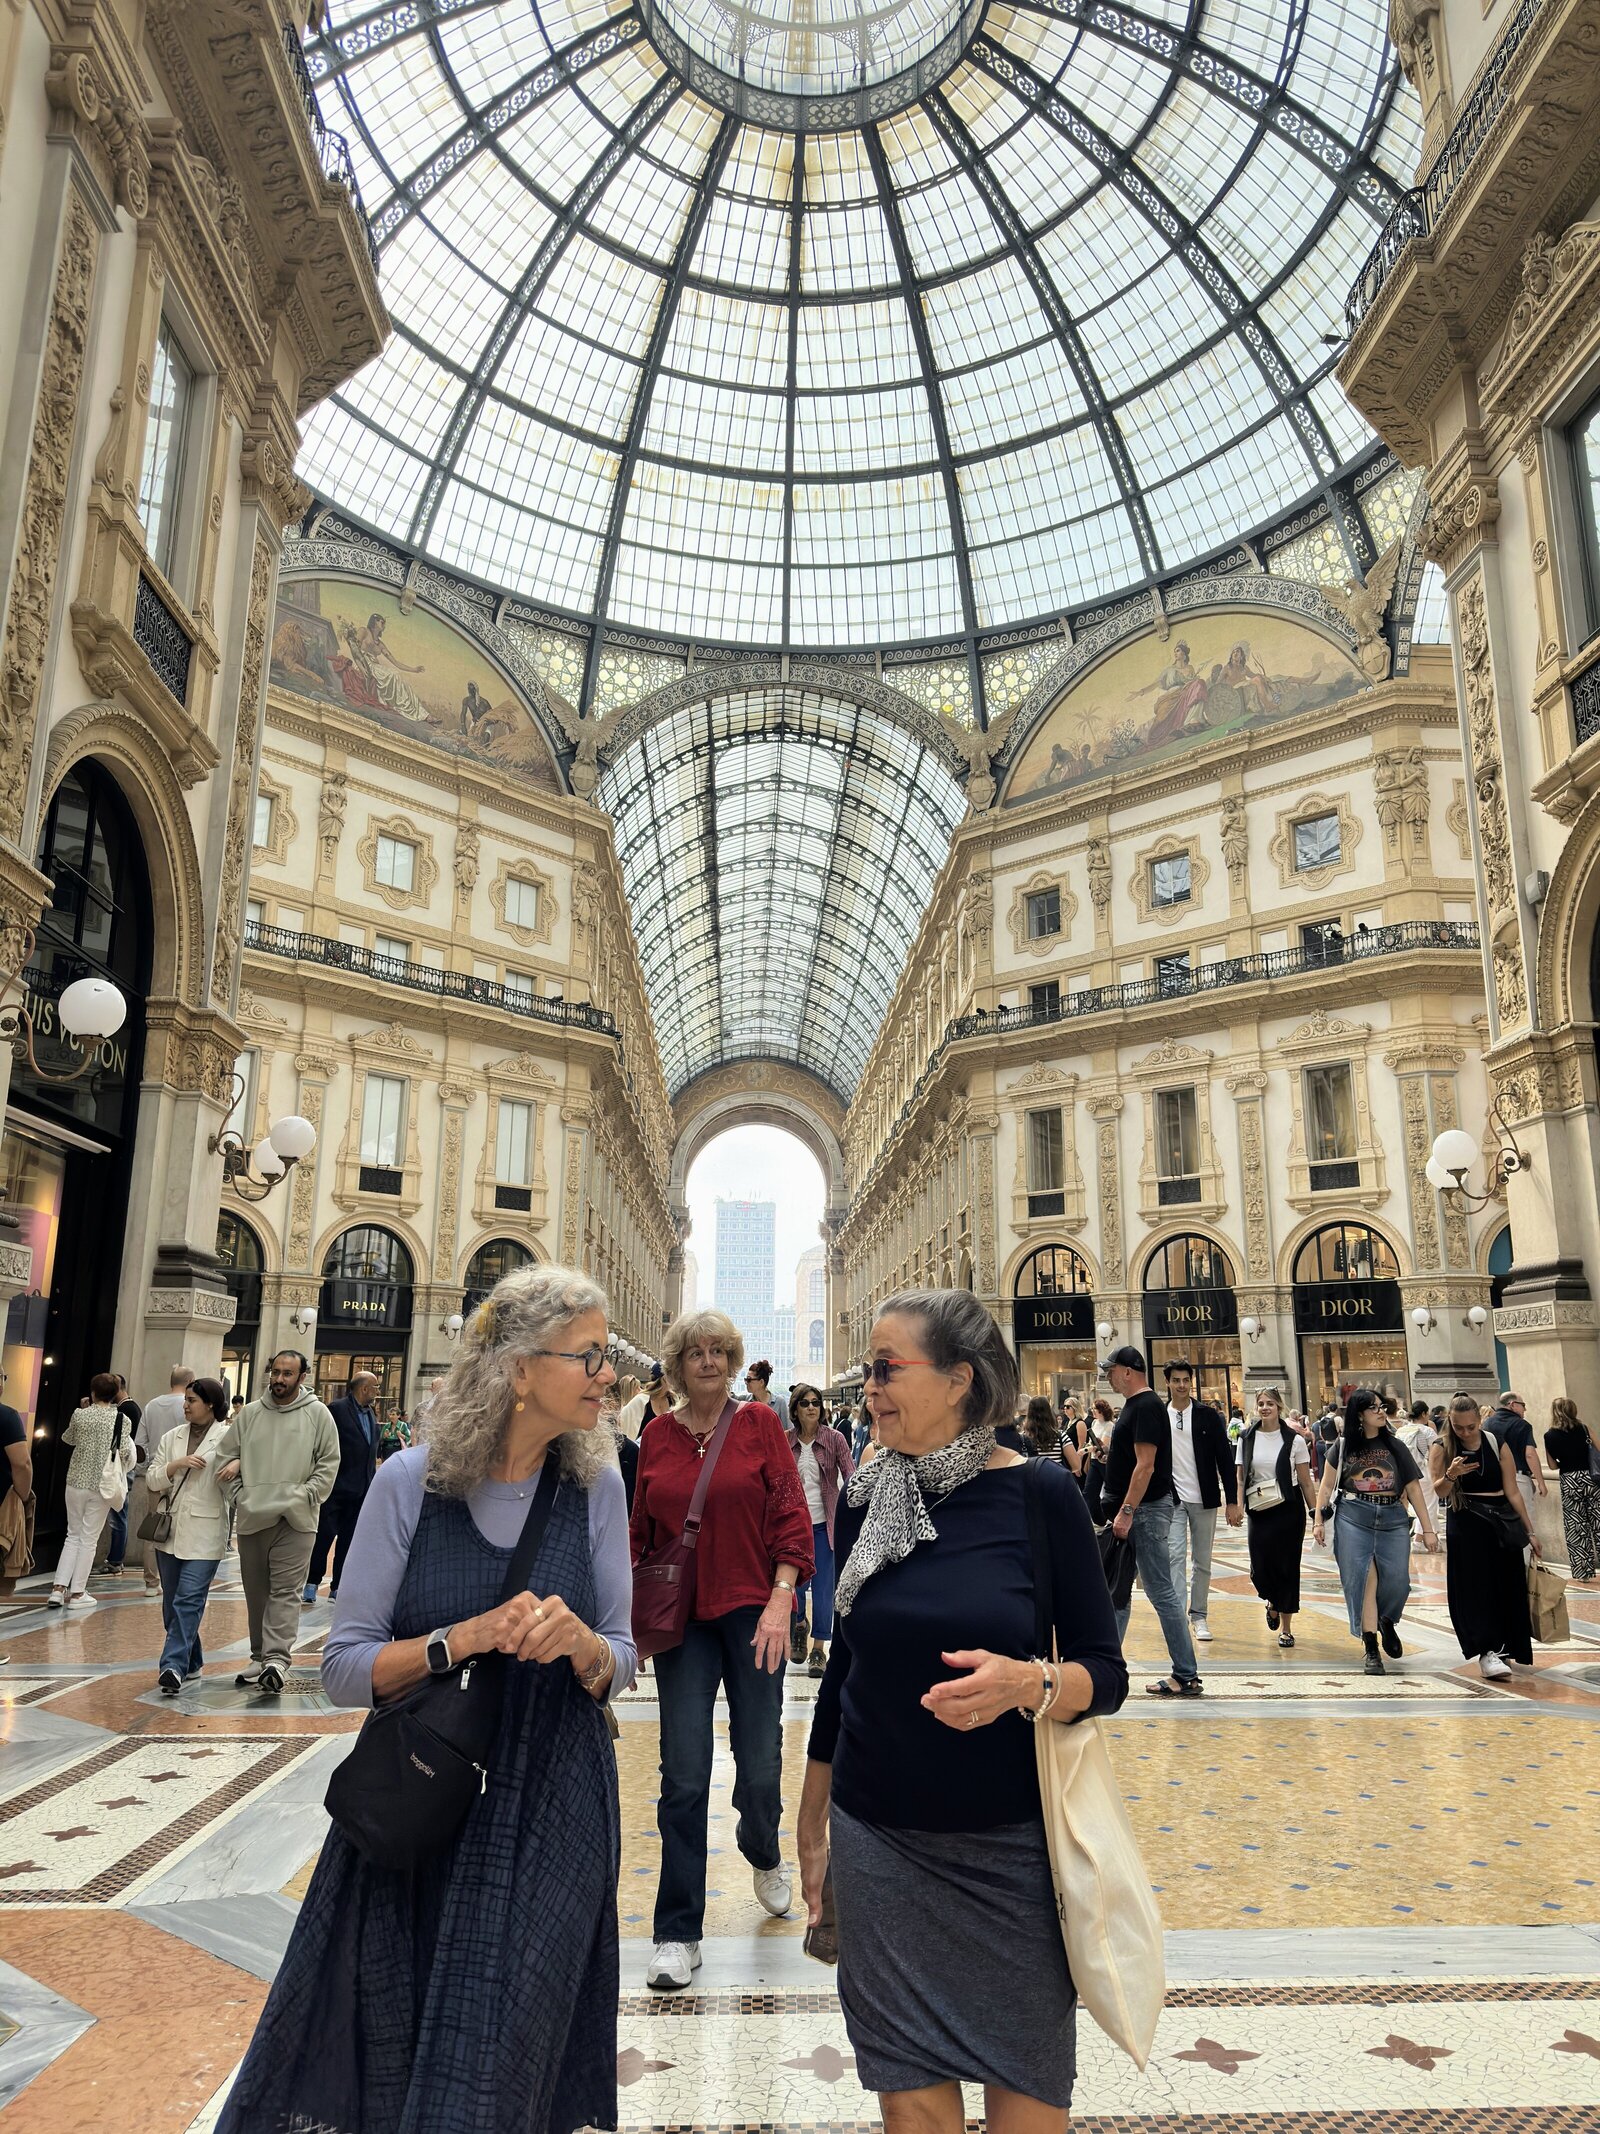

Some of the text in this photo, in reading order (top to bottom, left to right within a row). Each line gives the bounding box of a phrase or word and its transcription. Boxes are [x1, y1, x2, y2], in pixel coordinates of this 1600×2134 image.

[24, 990, 54, 1035] UIS
[343, 1300, 386, 1312] PRADA
[1166, 1305, 1213, 1322] DIOR
[1320, 1298, 1375, 1317] DIOR
[1033, 1311, 1074, 1327] DIOR
